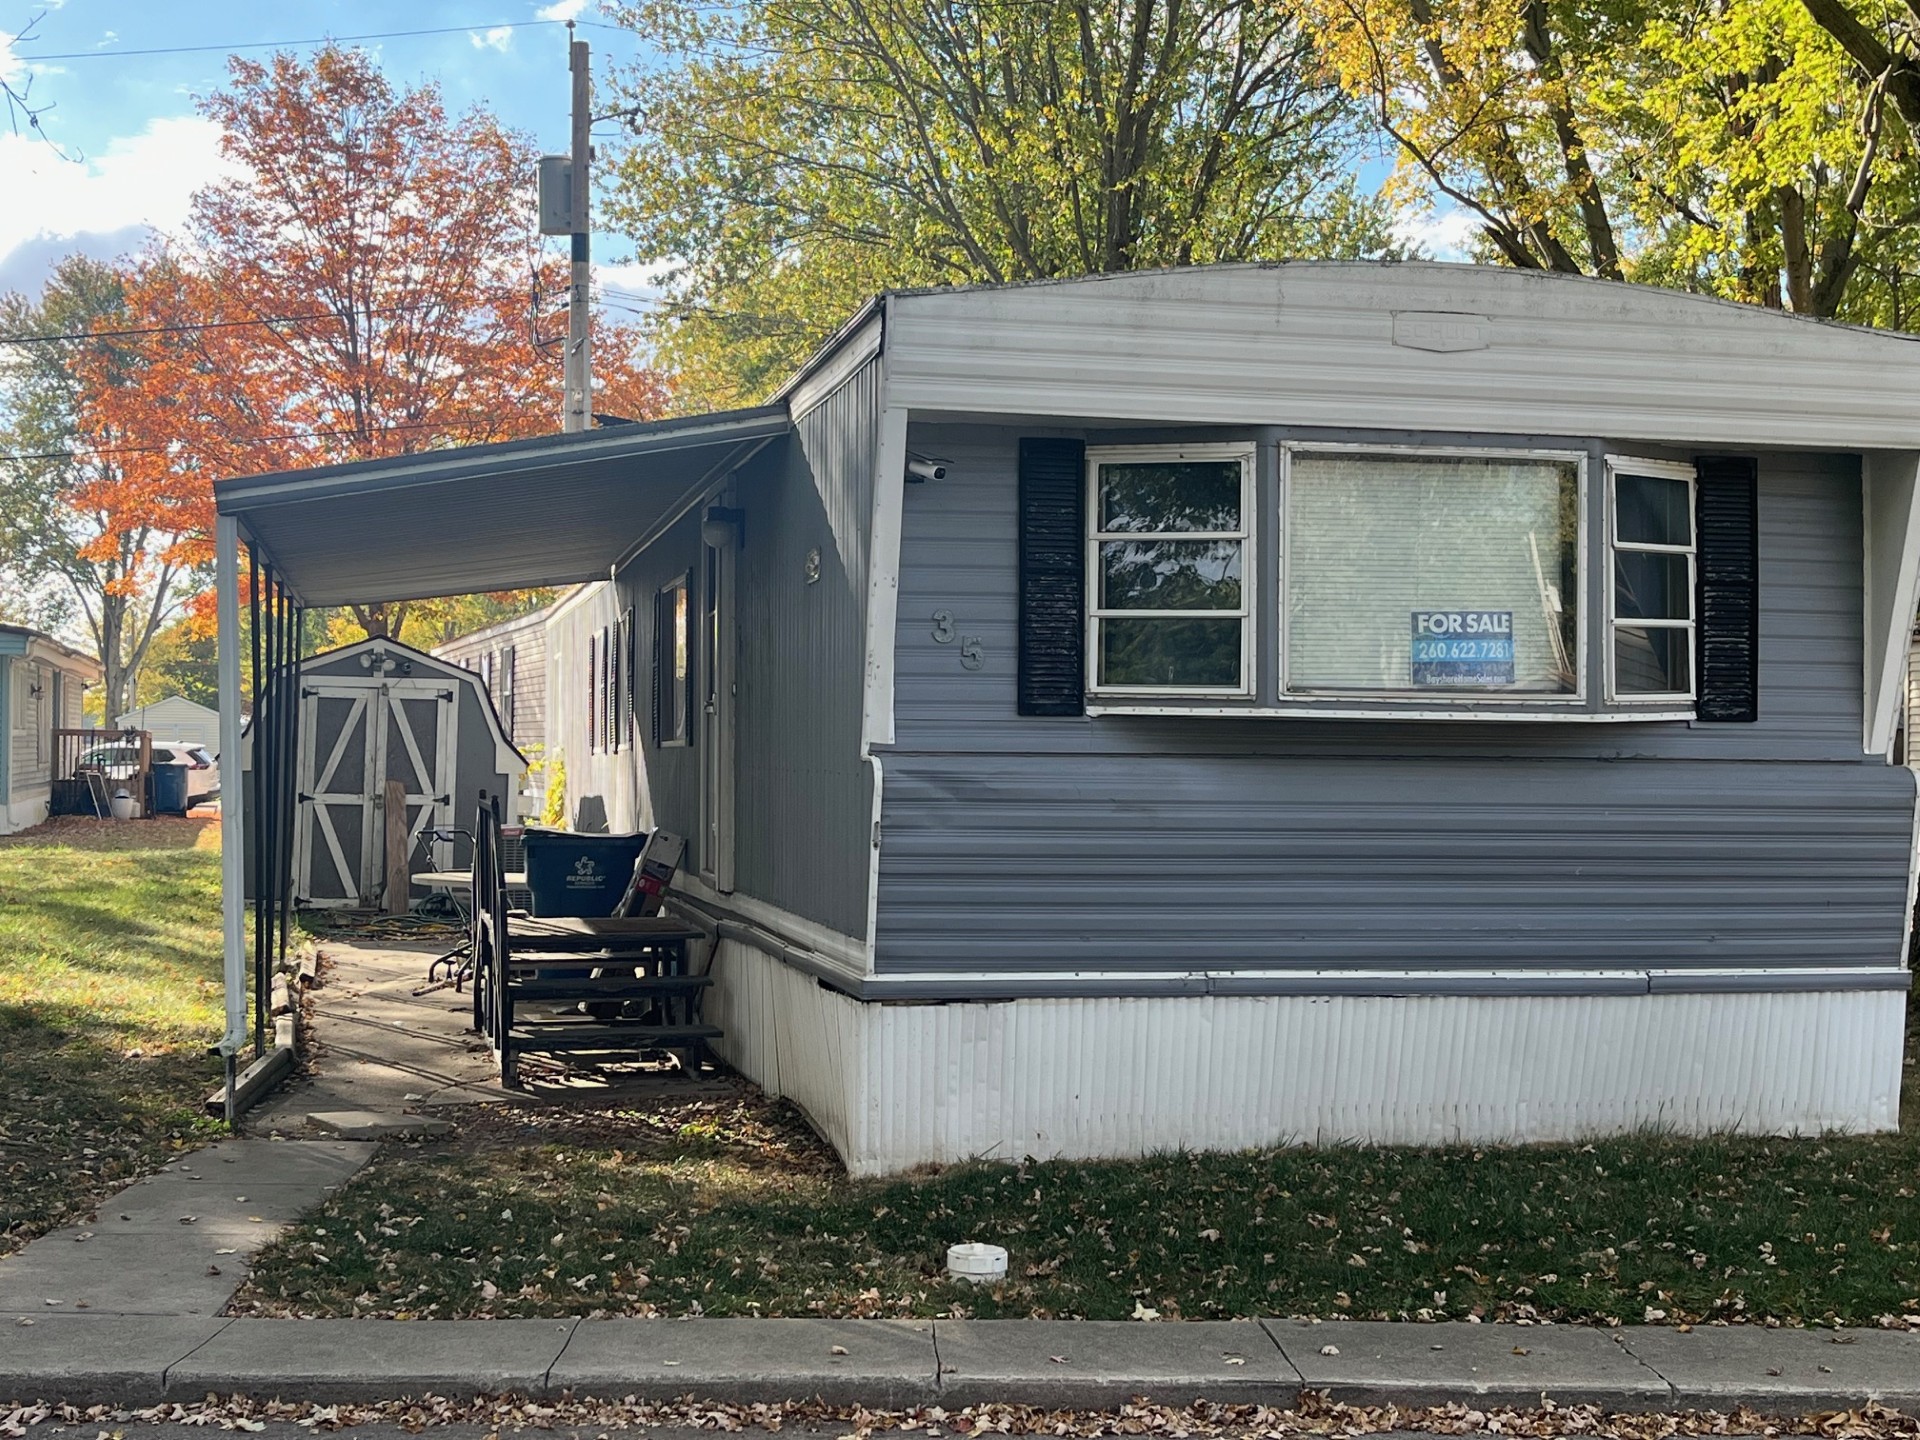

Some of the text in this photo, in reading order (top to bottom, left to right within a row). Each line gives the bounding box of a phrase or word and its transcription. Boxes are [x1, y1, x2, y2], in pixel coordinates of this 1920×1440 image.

[1418, 613, 1510, 633] FOR SALE
[931, 608, 985, 671] 35
[1418, 642, 1510, 658] 260.622.7281
